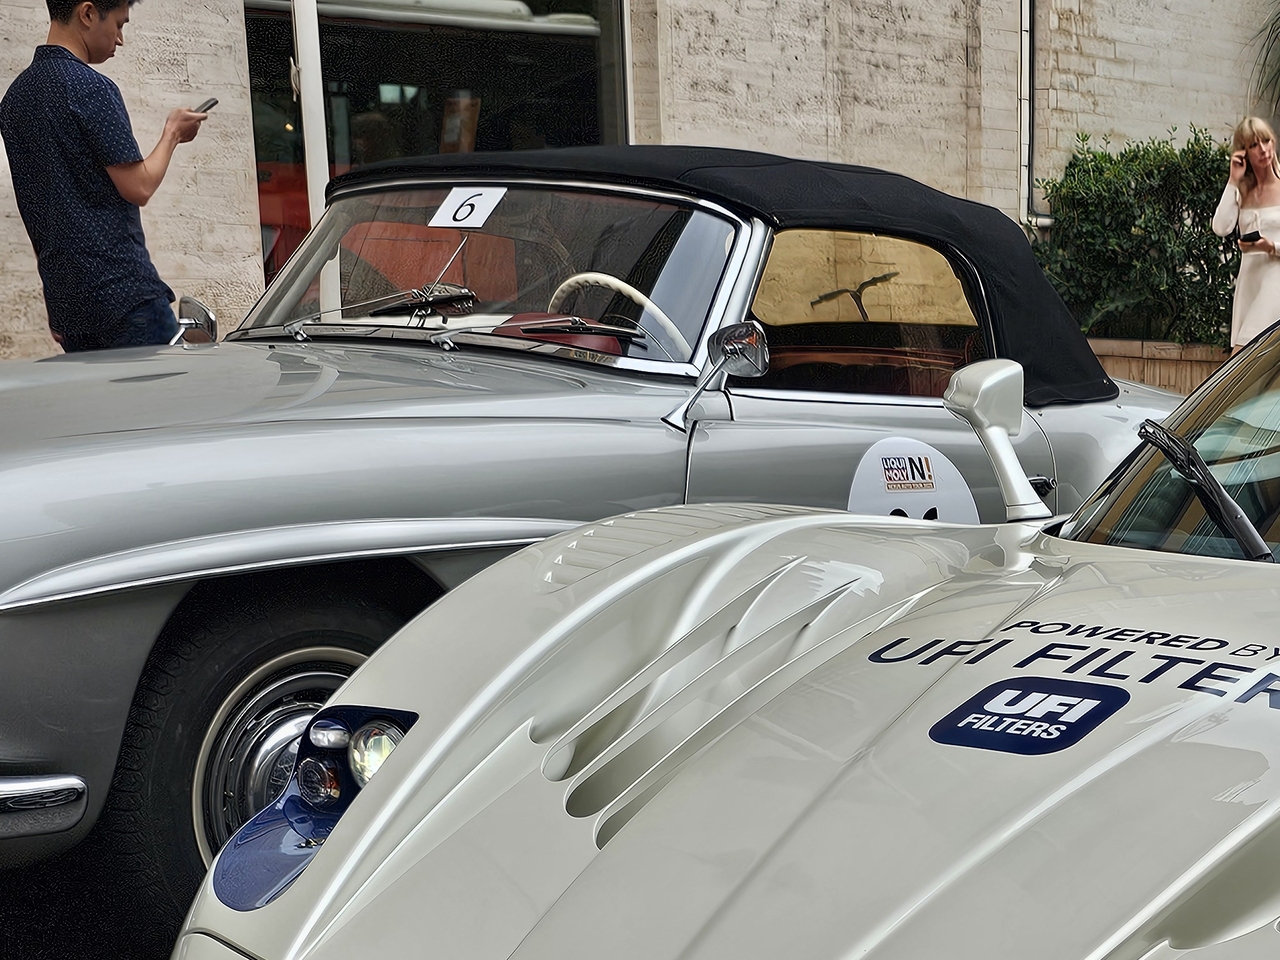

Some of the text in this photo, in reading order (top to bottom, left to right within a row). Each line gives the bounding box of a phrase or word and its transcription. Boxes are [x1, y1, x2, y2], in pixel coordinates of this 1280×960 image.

[452, 193, 483, 222] 6
[885, 469, 909, 481] MOLY
[1001, 620, 1228, 652] POWERED
[867, 637, 1013, 667] UFI
[982, 688, 1101, 722] UFI
[956, 711, 1067, 740] FILTERS
